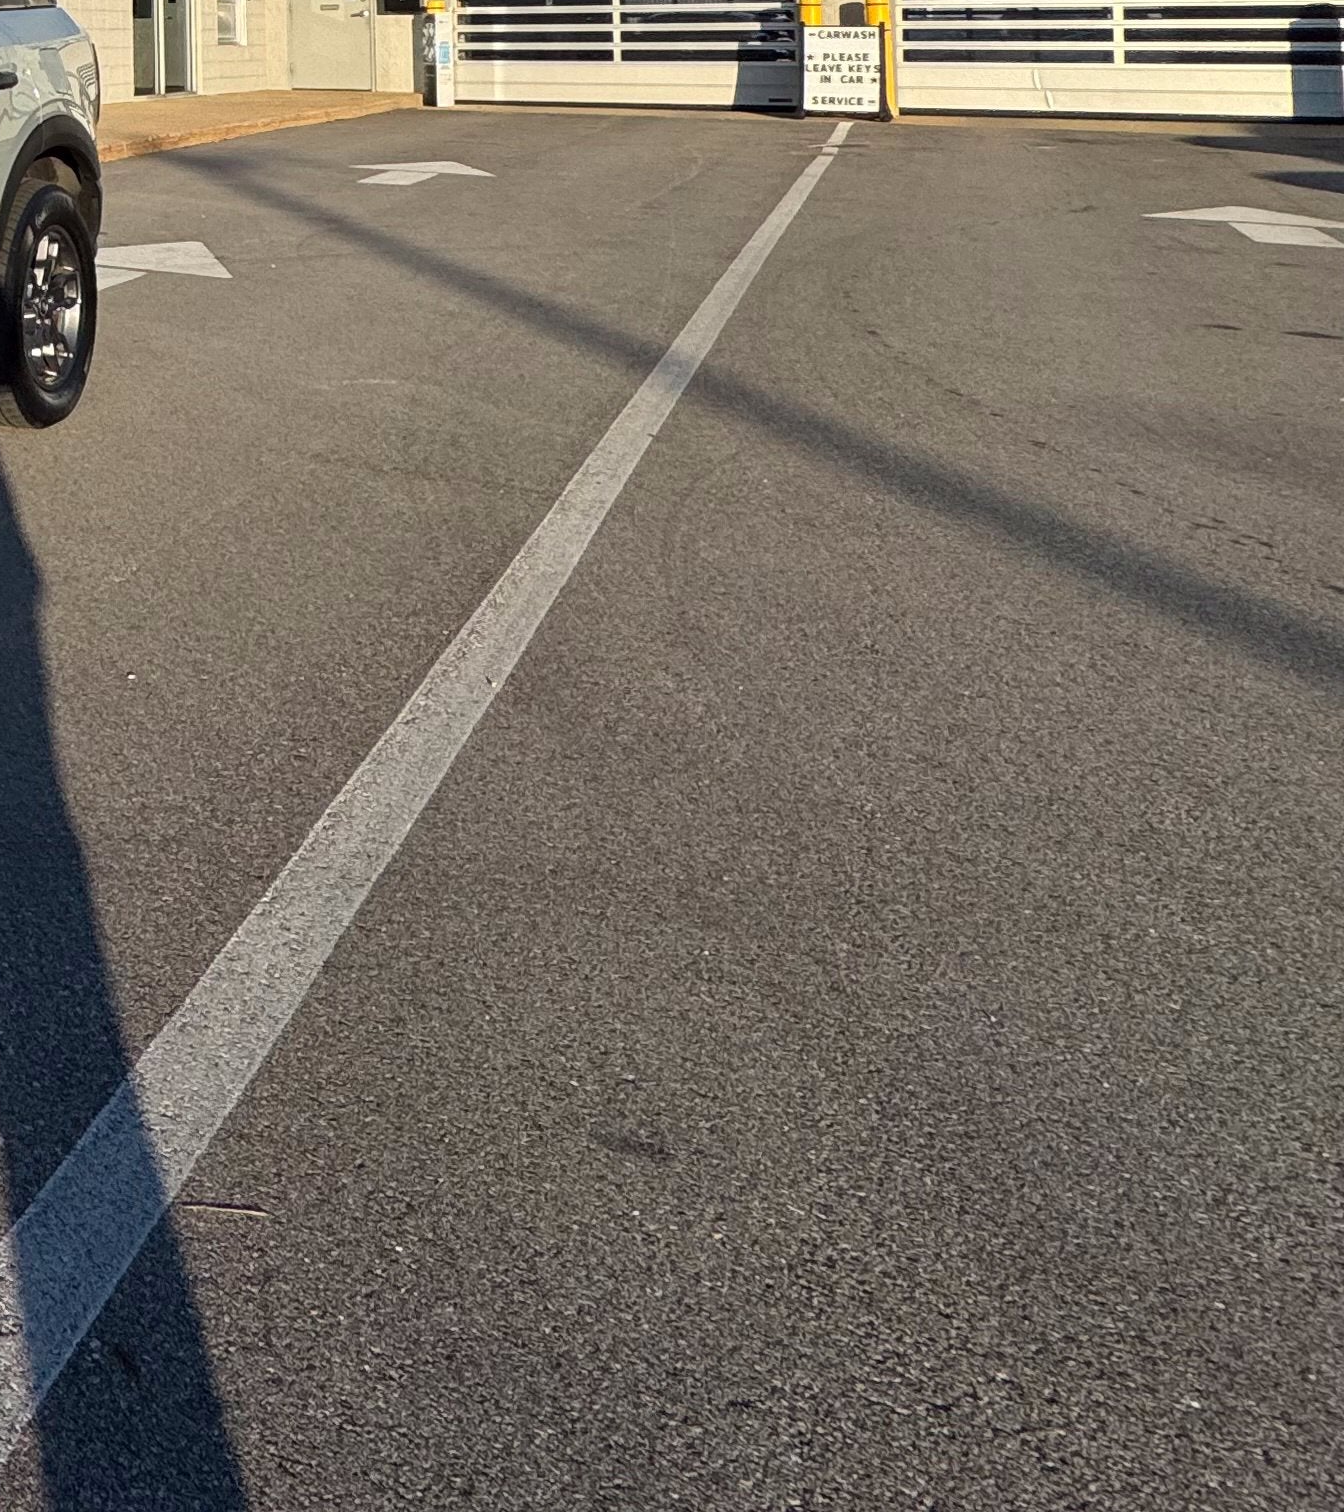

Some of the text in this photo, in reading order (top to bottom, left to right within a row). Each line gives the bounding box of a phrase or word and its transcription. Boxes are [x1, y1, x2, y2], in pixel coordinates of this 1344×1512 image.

[817, 30, 876, 39] CARWASH
[822, 52, 870, 62] PLEASE
[805, 64, 881, 74] LEAVE KEYS
[820, 75, 864, 84] IN CAR
[812, 96, 864, 106] SERVICE
